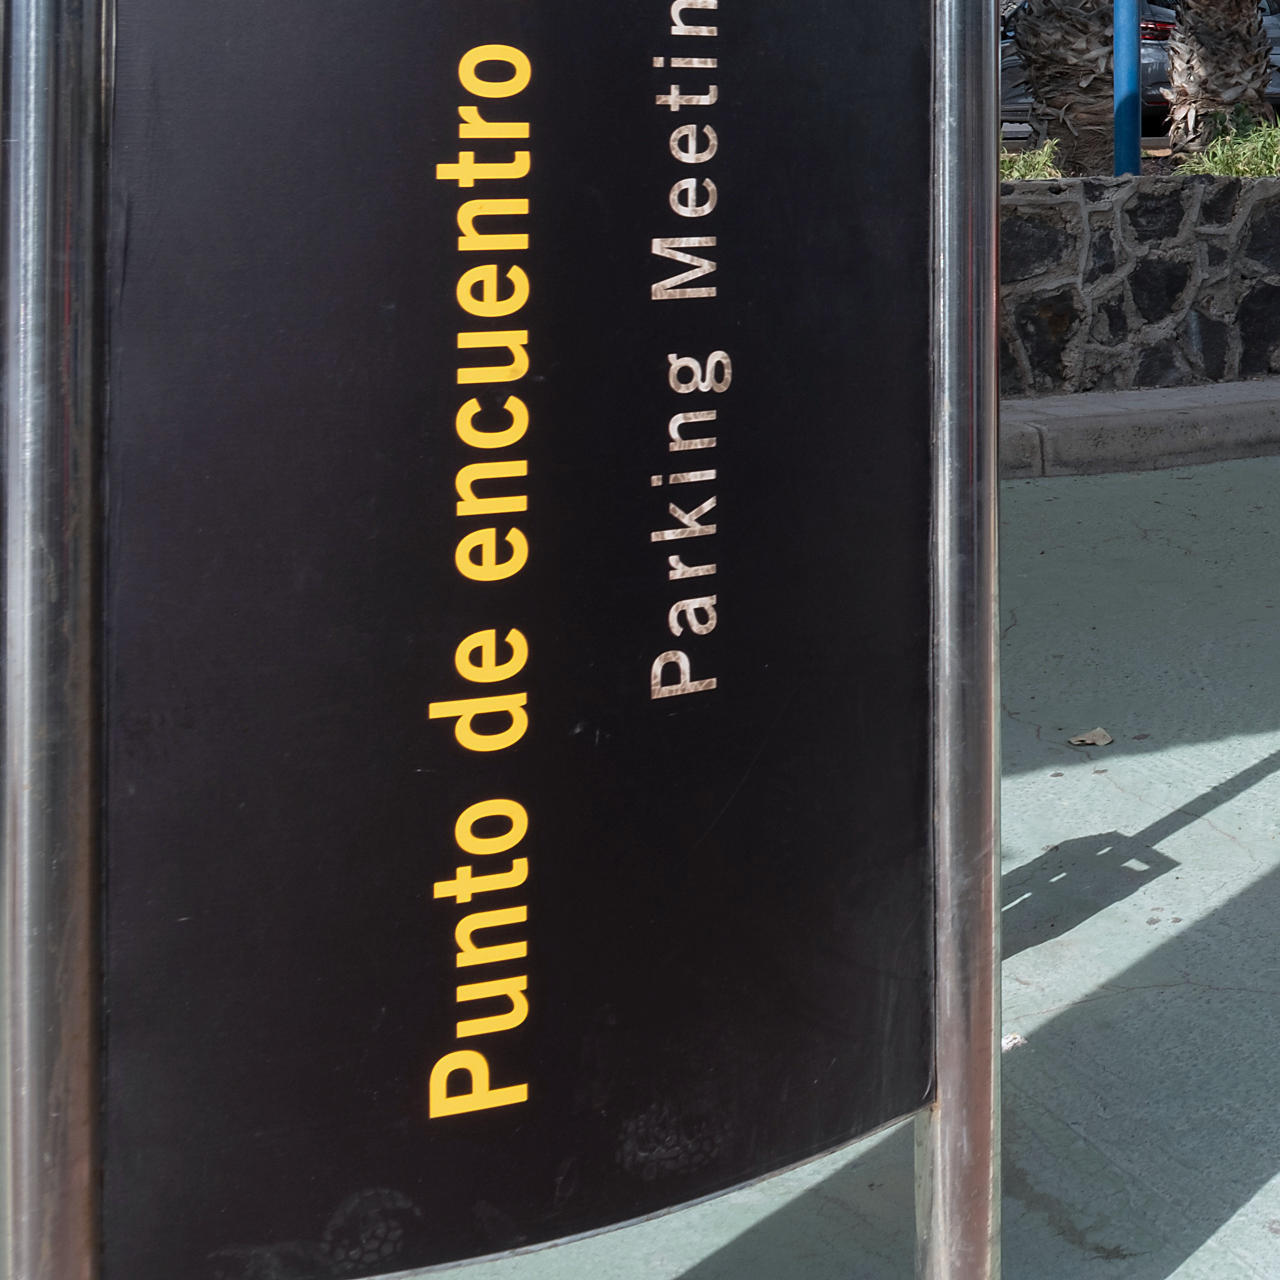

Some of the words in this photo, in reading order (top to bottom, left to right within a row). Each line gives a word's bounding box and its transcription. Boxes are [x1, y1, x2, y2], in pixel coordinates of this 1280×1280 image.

[436, 43, 531, 581] encuentro
[429, 628, 528, 752] de
[650, 350, 732, 699] Parking
[429, 799, 529, 1119] Punto
